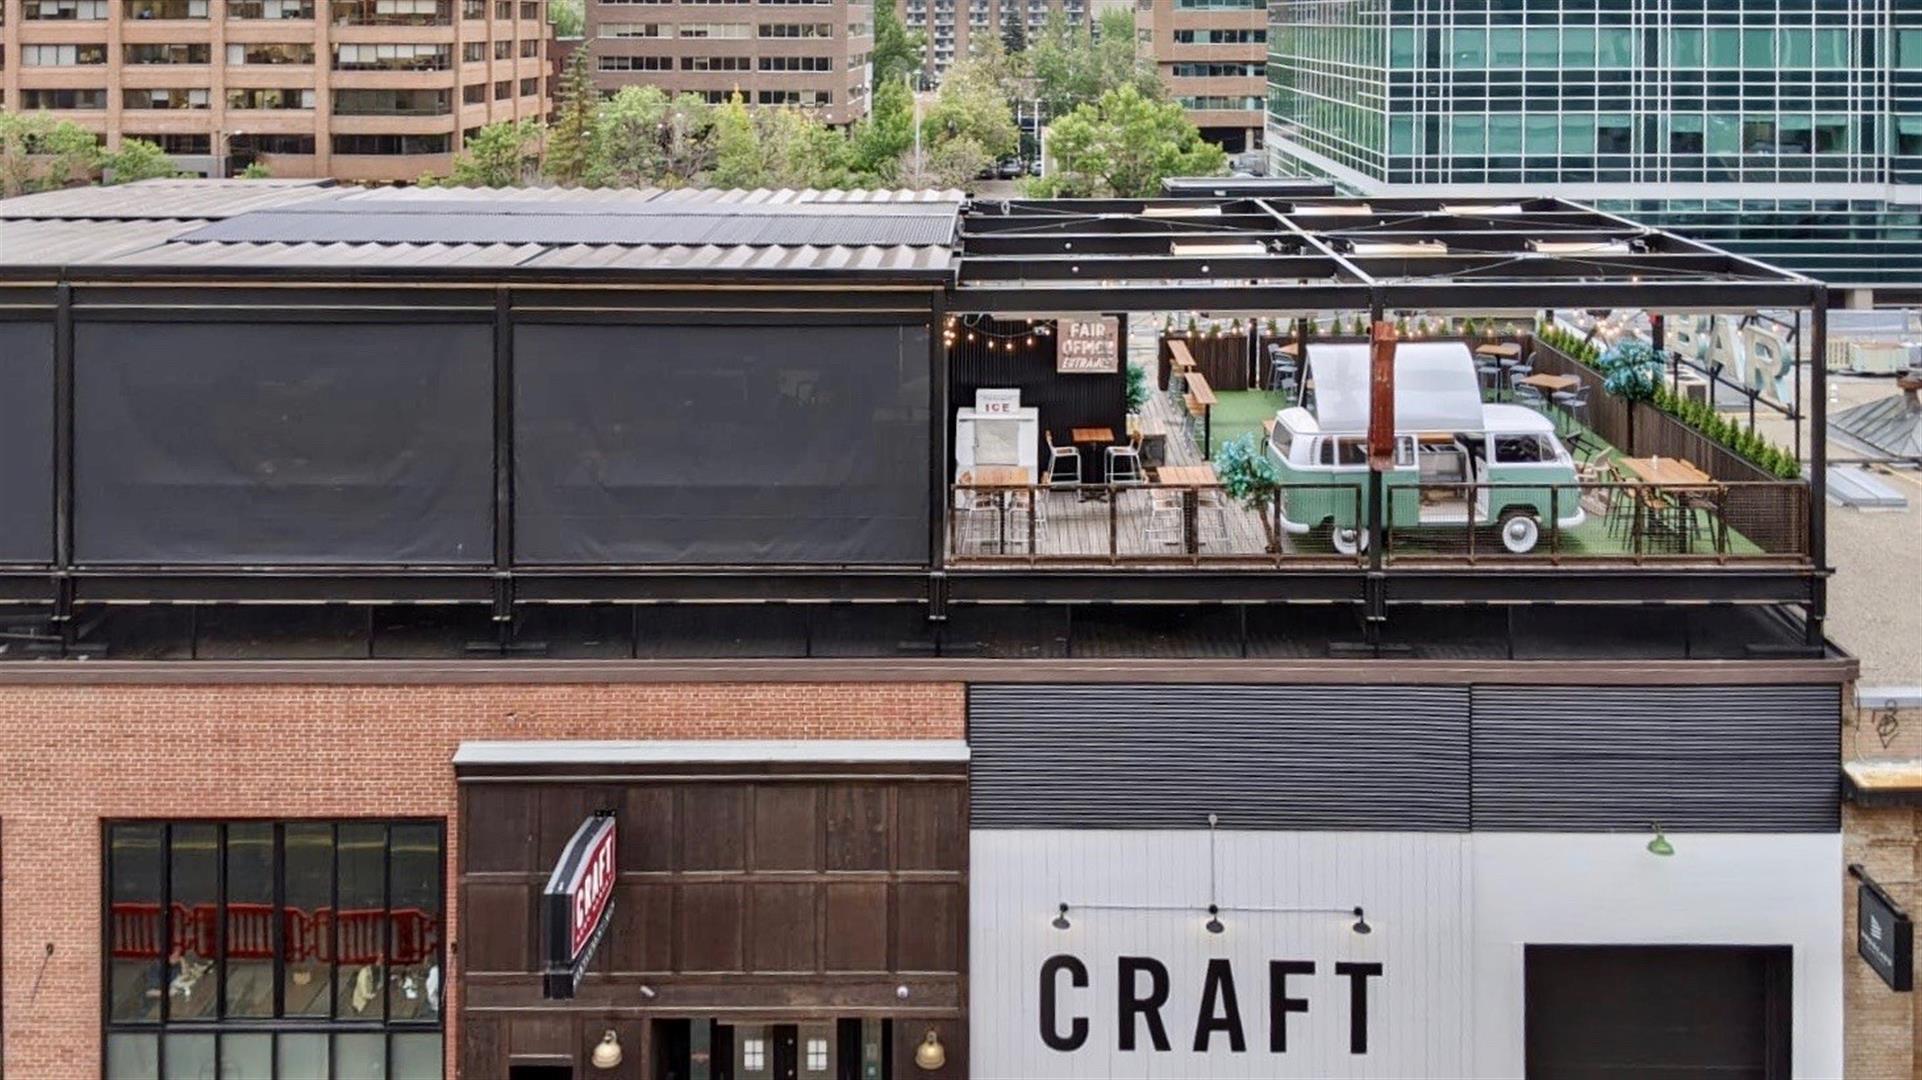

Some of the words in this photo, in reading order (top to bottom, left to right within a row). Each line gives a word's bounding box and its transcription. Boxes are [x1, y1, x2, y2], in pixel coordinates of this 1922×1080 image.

[1070, 322, 1106, 338] FAIR
[1664, 314, 1791, 404] BAR
[985, 403, 1009, 412] ICE
[576, 835, 612, 929] CRAFT
[1040, 954, 1383, 1054] CRAFT
